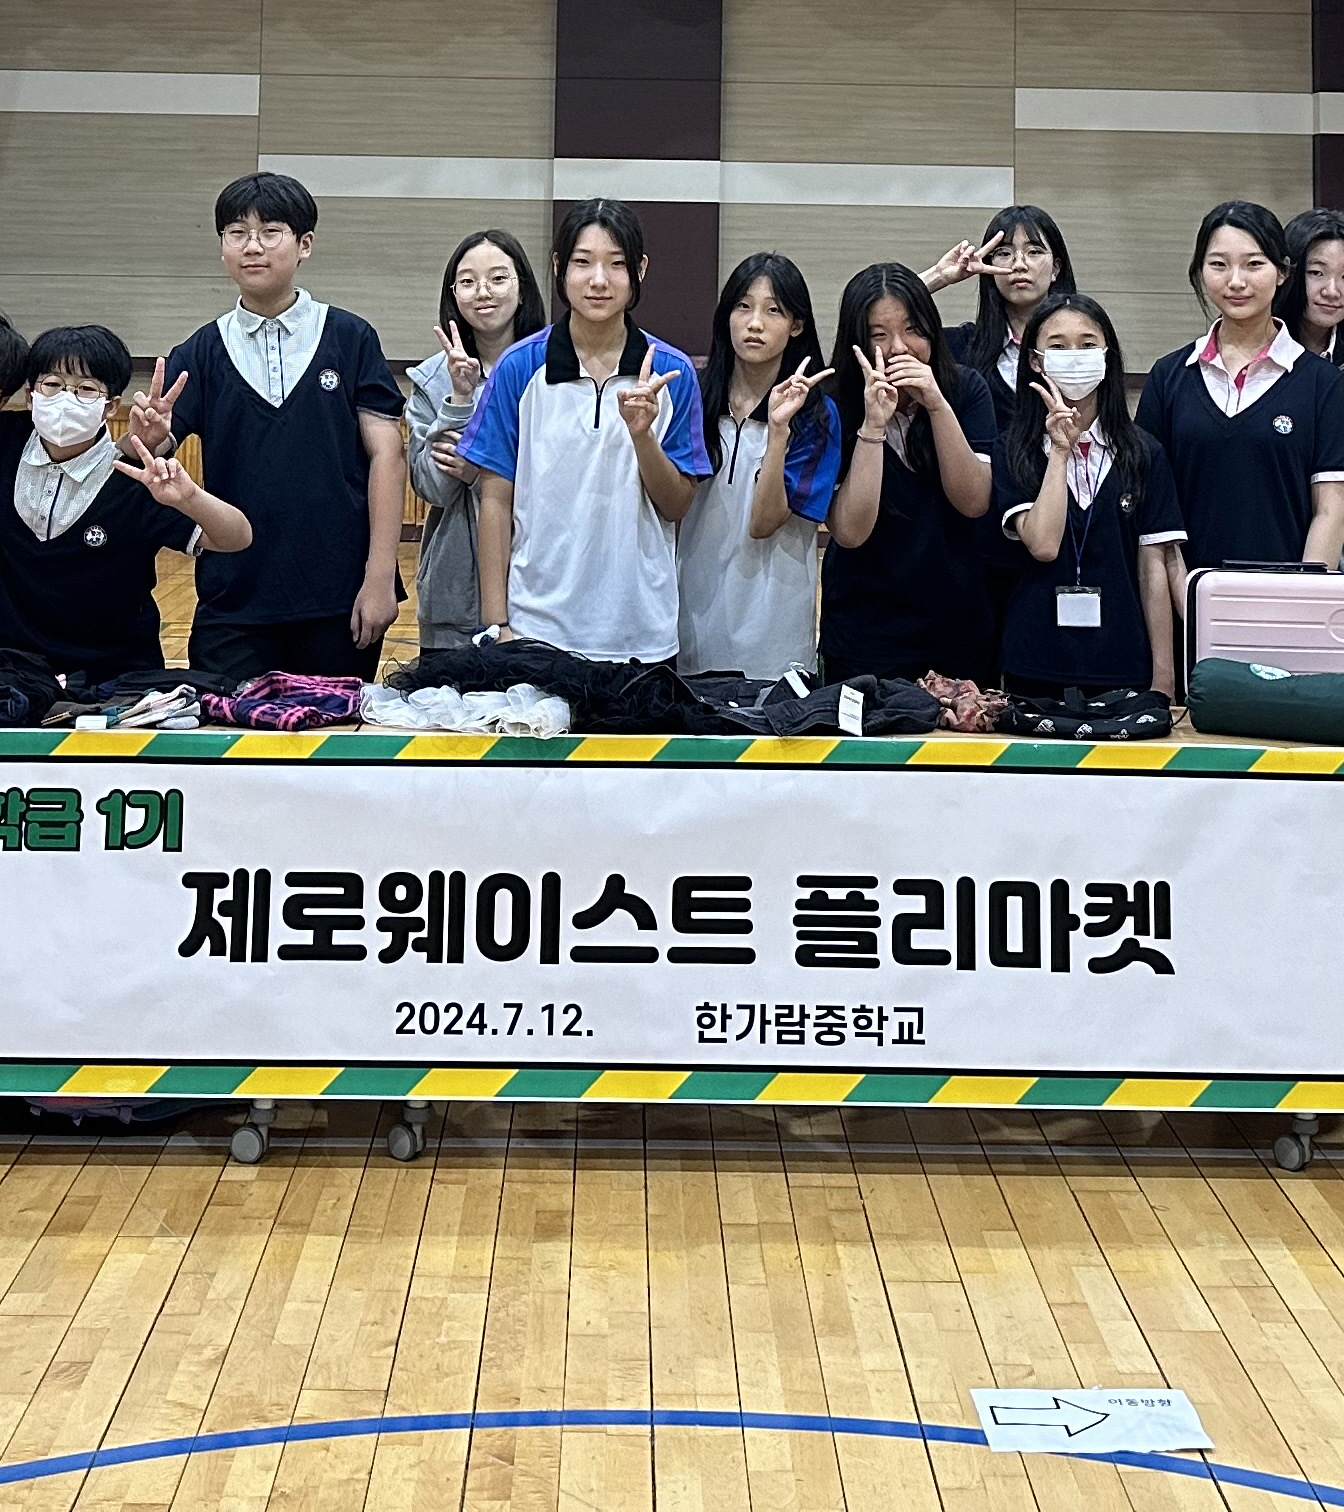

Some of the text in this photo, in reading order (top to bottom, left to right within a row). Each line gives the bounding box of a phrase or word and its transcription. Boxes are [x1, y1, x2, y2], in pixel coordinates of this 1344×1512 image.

[96, 787, 184, 853] 1기
[177, 867, 1176, 976] 제로웨이스트 플리마켓
[395, 1001, 594, 1037] 2024.7.12.
[695, 1001, 926, 1047] 한가람중학교
